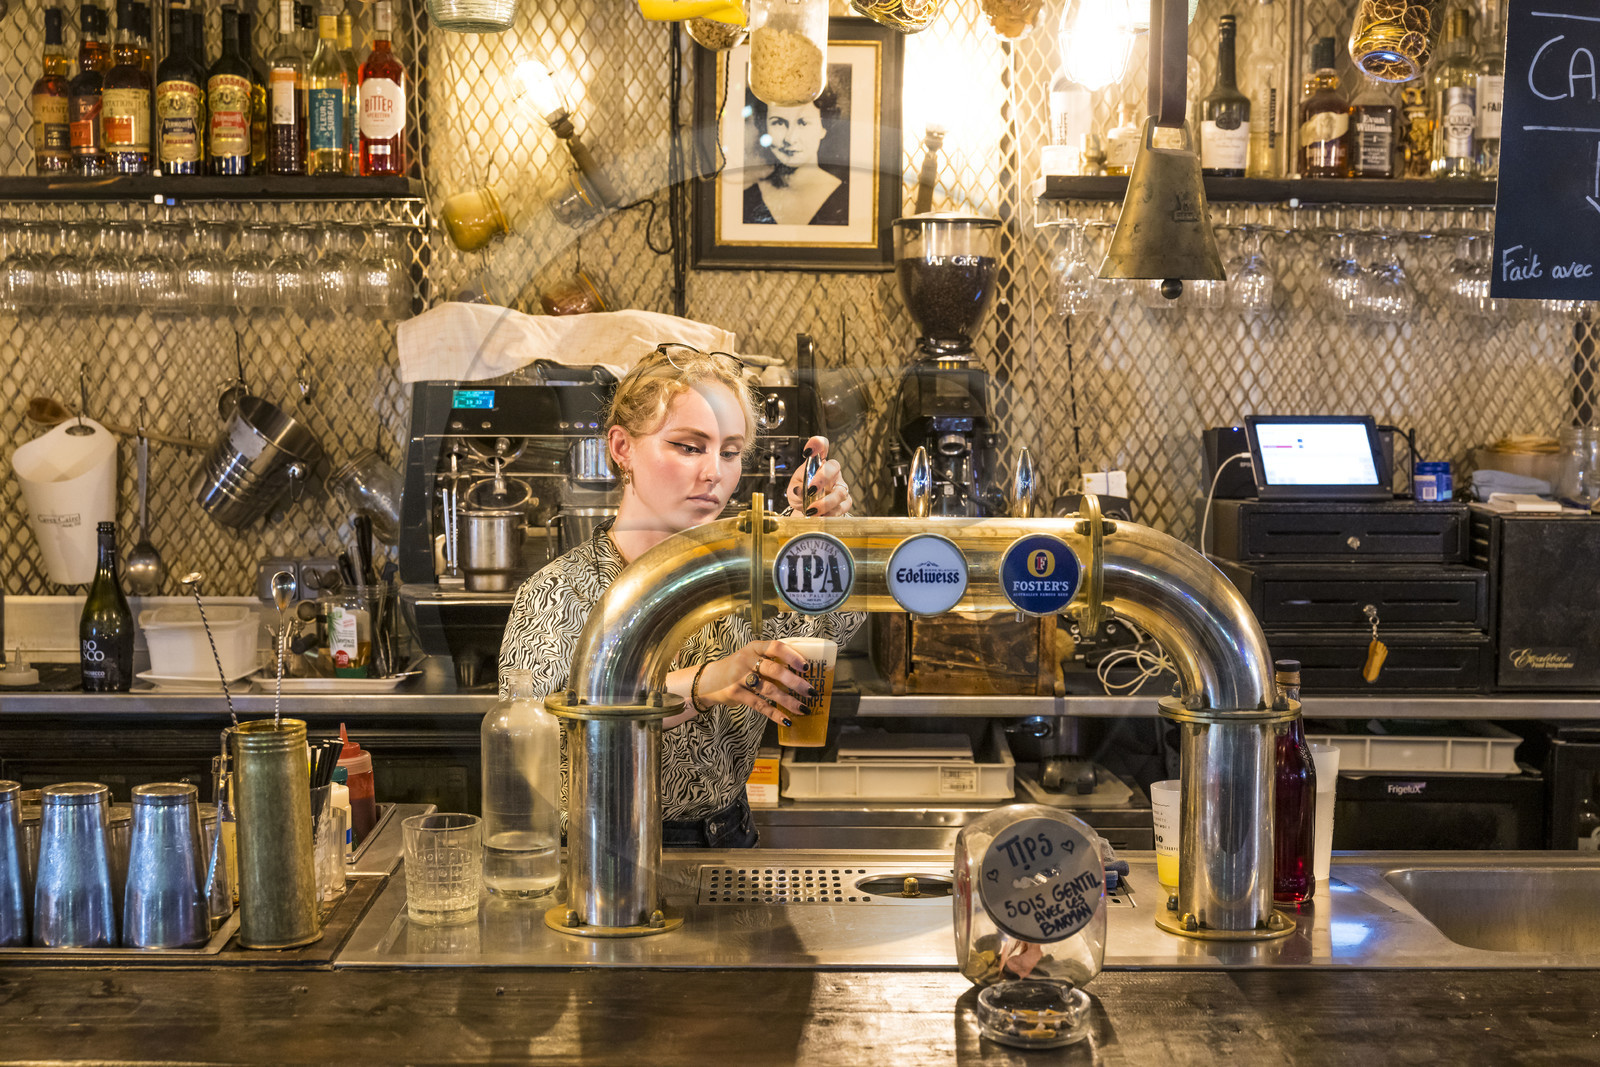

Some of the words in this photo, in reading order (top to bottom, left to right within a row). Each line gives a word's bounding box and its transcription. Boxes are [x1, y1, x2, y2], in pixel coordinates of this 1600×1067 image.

[320, 105, 328, 131] FLEUR
[327, 99, 335, 132] SUREAU
[364, 95, 393, 112] BITTER
[1502, 245, 1543, 282] Fait
[1552, 261, 1593, 279] avec
[789, 540, 840, 556] LAGUNITAS
[785, 554, 844, 593] IPA
[896, 567, 960, 584] Edelweiss
[1012, 580, 1070, 592] FOSTER'S
[1005, 893, 1046, 918] SOIS
[1052, 870, 1102, 902] GENTIL
[1034, 903, 1065, 923] AVEC
[1066, 894, 1086, 909] LES
[1040, 903, 1093, 938] BARMAN
